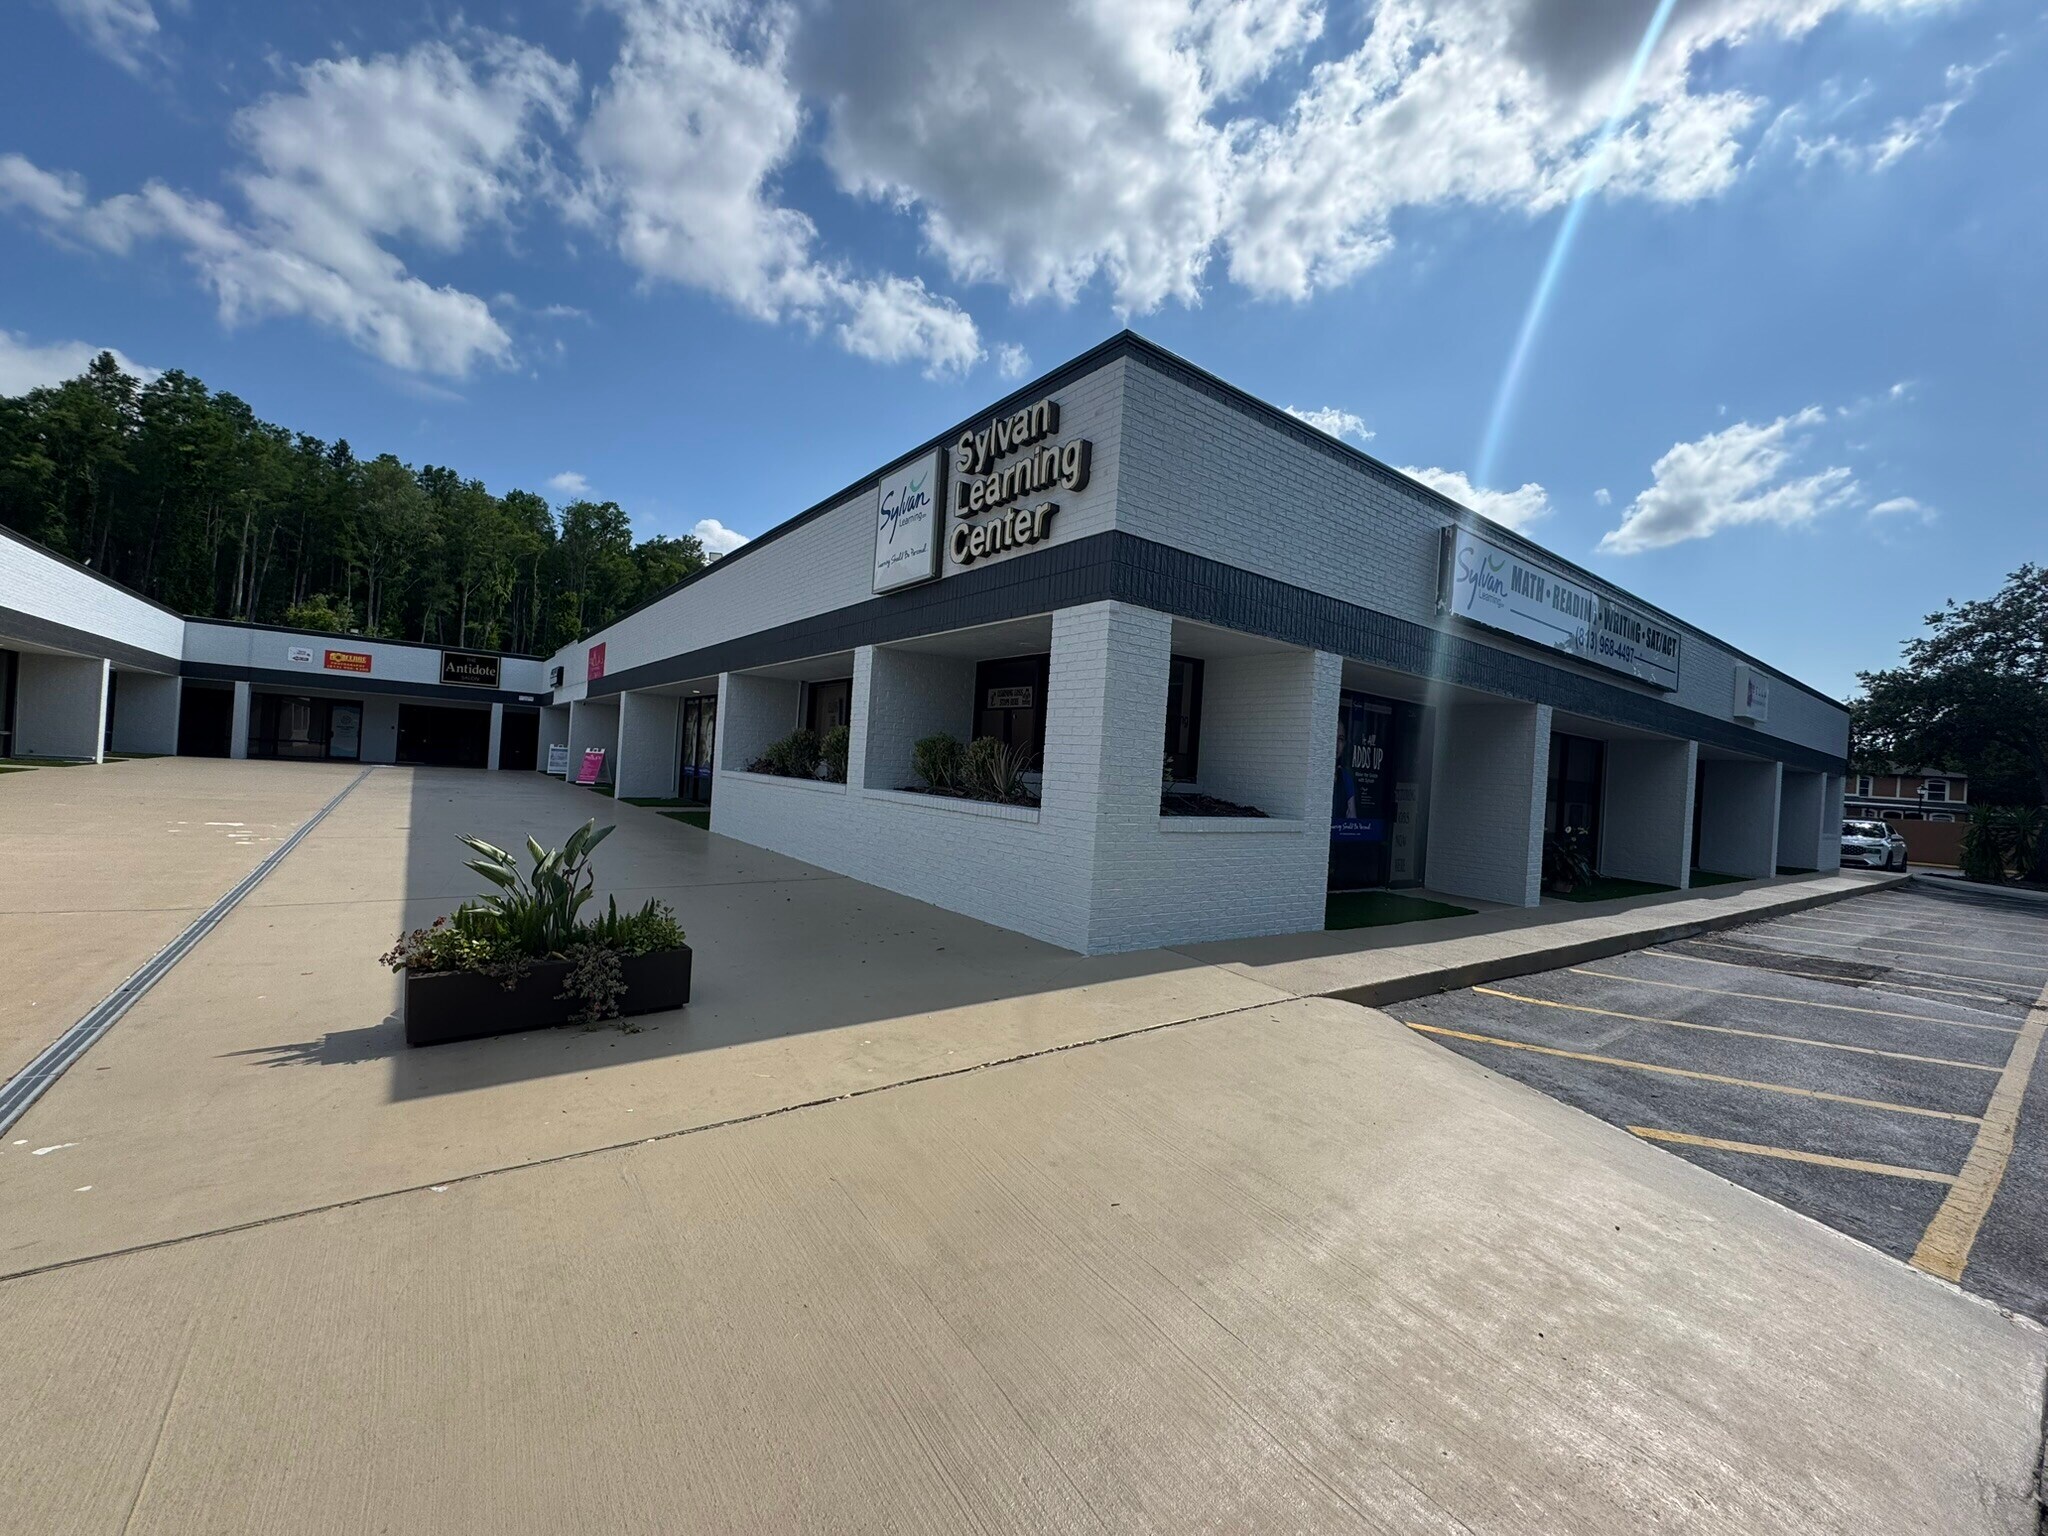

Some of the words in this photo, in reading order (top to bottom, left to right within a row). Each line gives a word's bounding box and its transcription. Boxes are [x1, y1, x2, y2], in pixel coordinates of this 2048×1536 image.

[955, 399, 1060, 475] Sylvan
[953, 438, 1093, 519] Learning
[880, 486, 930, 544] Sylvan
[899, 511, 922, 528] Learning
[950, 502, 1060, 565] Center
[1456, 547, 1508, 610] Sylvan
[1511, 565, 1545, 604] MATH
[1604, 607, 1642, 643] WRITING
[1645, 627, 1677, 658] SAT/ACT
[445, 661, 496, 676] Antidote
[1575, 625, 1597, 655] (813)
[1599, 635, 1635, 663] 968-4497
[1351, 744, 1371, 769] ADDS
[1373, 746, 1384, 770] UP
